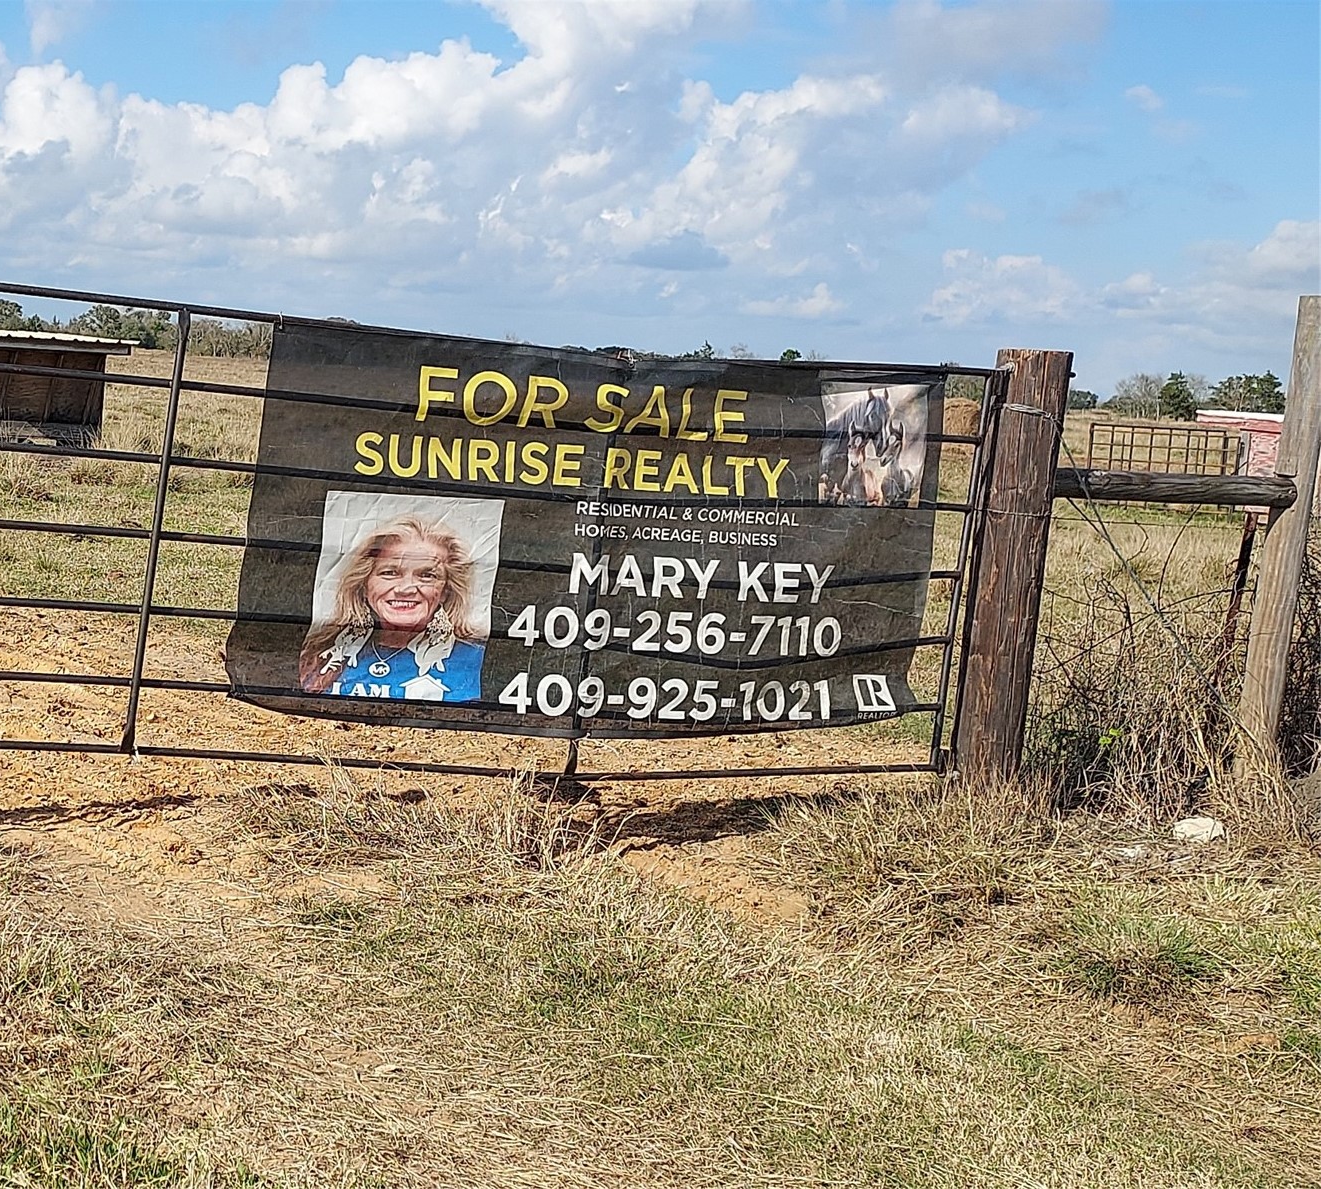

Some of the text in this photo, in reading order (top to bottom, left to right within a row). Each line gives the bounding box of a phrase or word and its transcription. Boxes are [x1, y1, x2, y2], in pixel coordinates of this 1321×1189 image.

[415, 365, 749, 443] FOR SALE
[354, 432, 790, 498] SUNRISE REALTY
[574, 523, 778, 546] HOMES, ACREAGE, BUSINESS
[576, 501, 799, 527] RESIDENTIAL & COMMERCIAL
[568, 552, 835, 604] MARY KEY
[507, 605, 842, 657] 409-256-7110
[330, 682, 391, 698] I AM
[498, 672, 830, 722] 409-925-1021
